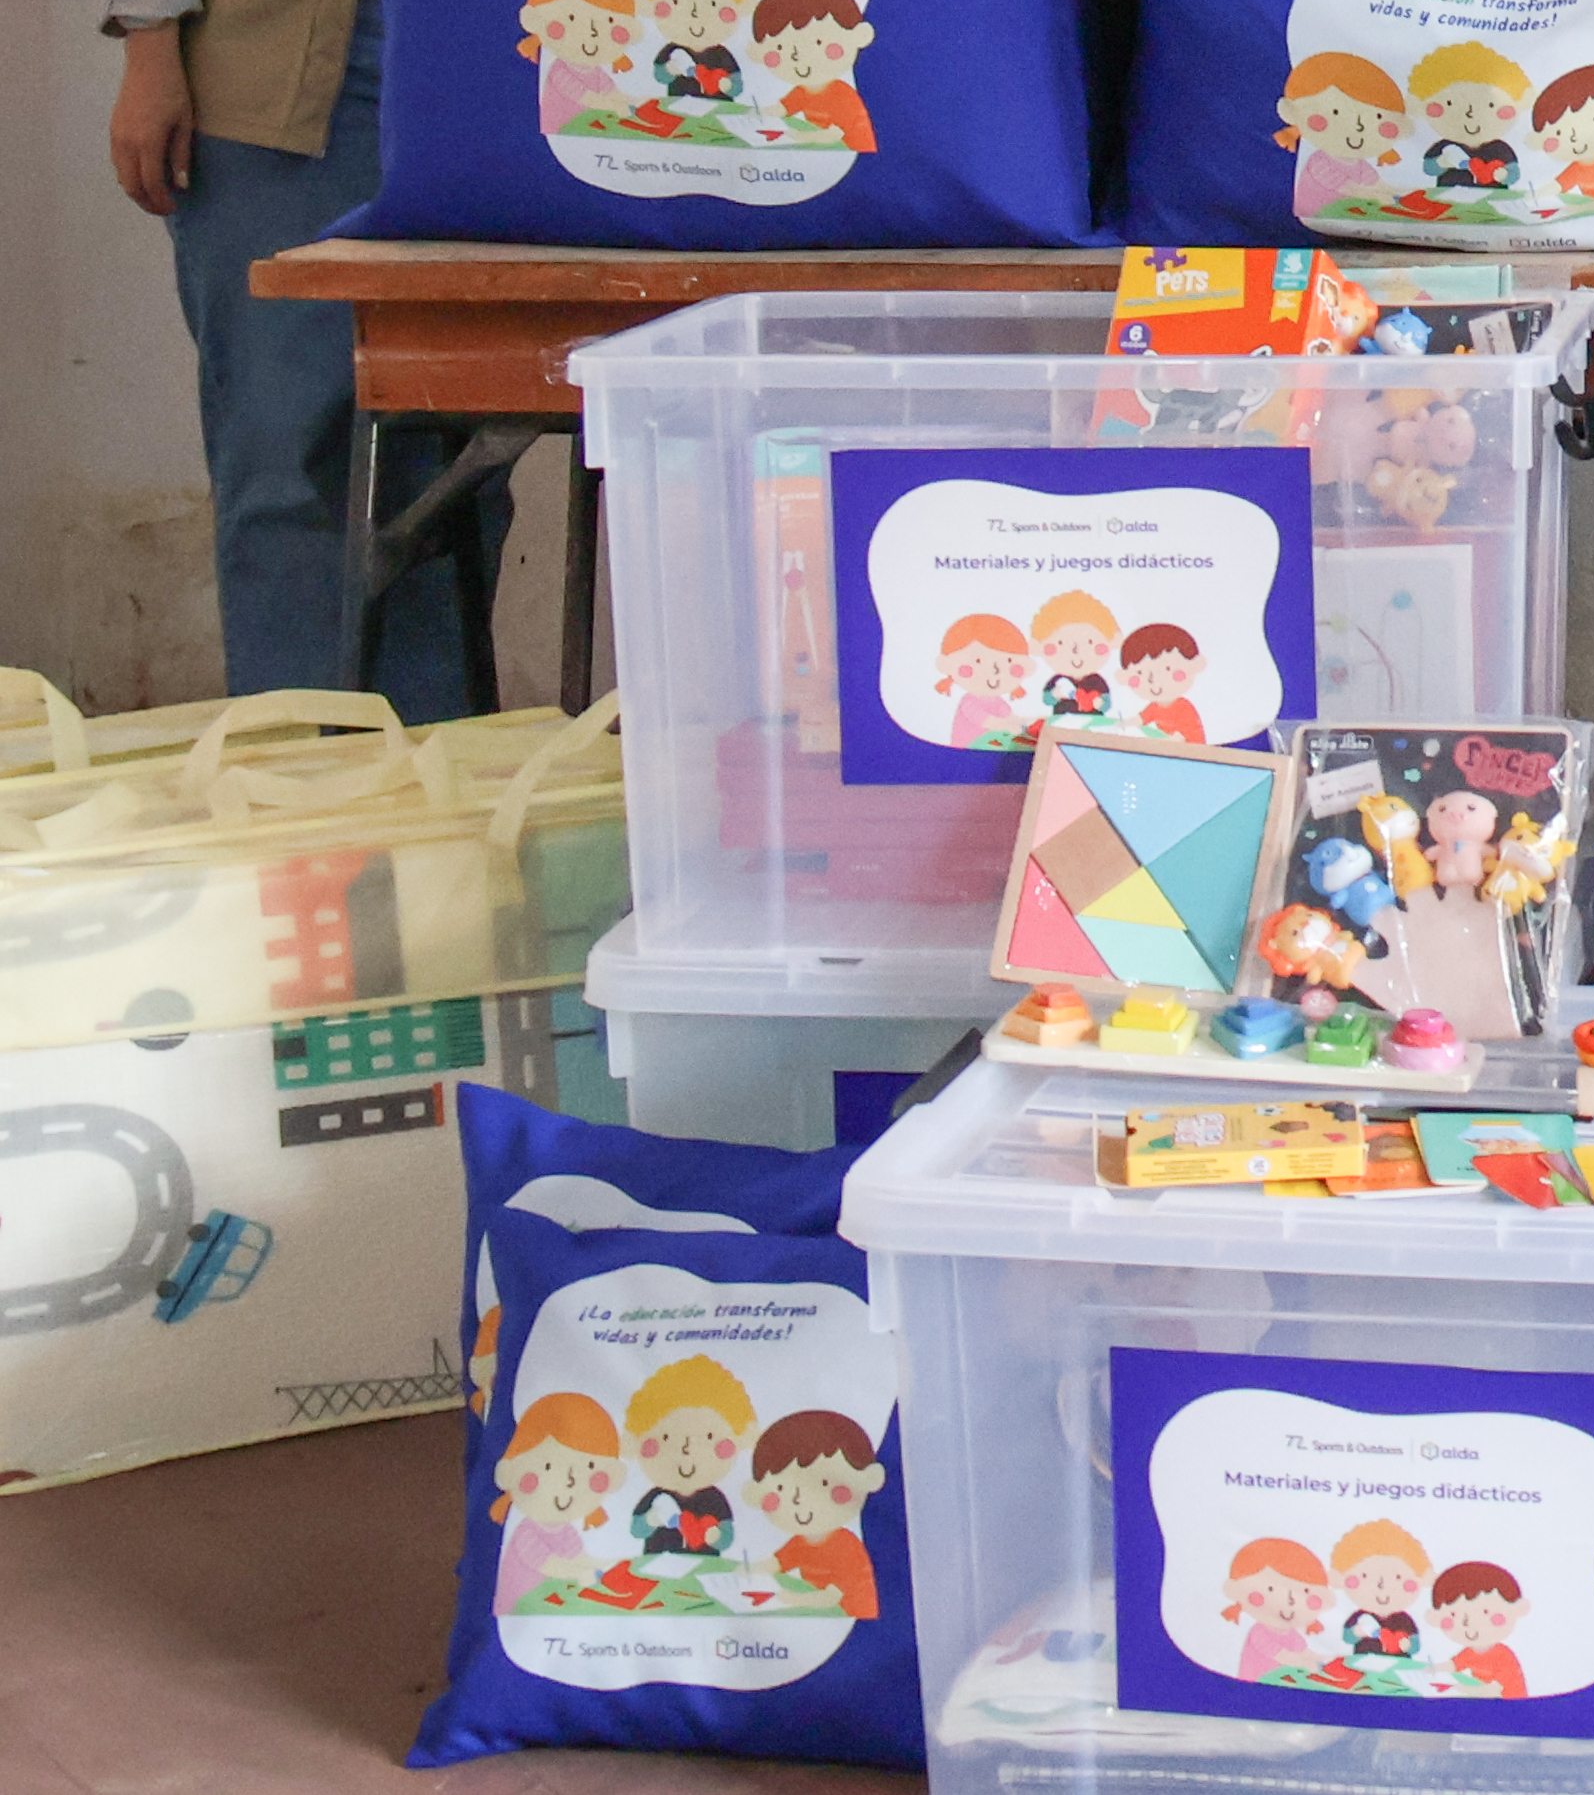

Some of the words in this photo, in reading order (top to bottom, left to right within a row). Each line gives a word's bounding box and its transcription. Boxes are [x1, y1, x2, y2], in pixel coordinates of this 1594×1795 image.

[1370, 0, 1412, 18] vidas
[1419, 11, 1430, 26] y
[1438, 13, 1557, 32] comunidades!
[763, 169, 804, 182] alda
[1129, 325, 1142, 341] 6
[1123, 520, 1158, 532] alda
[935, 555, 1030, 569] Materiales
[1035, 558, 1045, 572] y
[1049, 554, 1112, 572] juegos
[1118, 554, 1214, 568] didácticos
[579, 1305, 611, 1322] ¡La
[620, 1306, 706, 1322] educación
[714, 1301, 817, 1318] transforma
[594, 1329, 639, 1344] vidas
[644, 1332, 657, 1348] y
[665, 1323, 793, 1342] comunidades!
[1441, 1447, 1479, 1460] alda
[1225, 1471, 1331, 1492] Materiales
[1338, 1482, 1349, 1497] y
[1354, 1479, 1425, 1500] juegos
[1433, 1484, 1541, 1503] didácticos
[743, 1641, 789, 1660] alda
